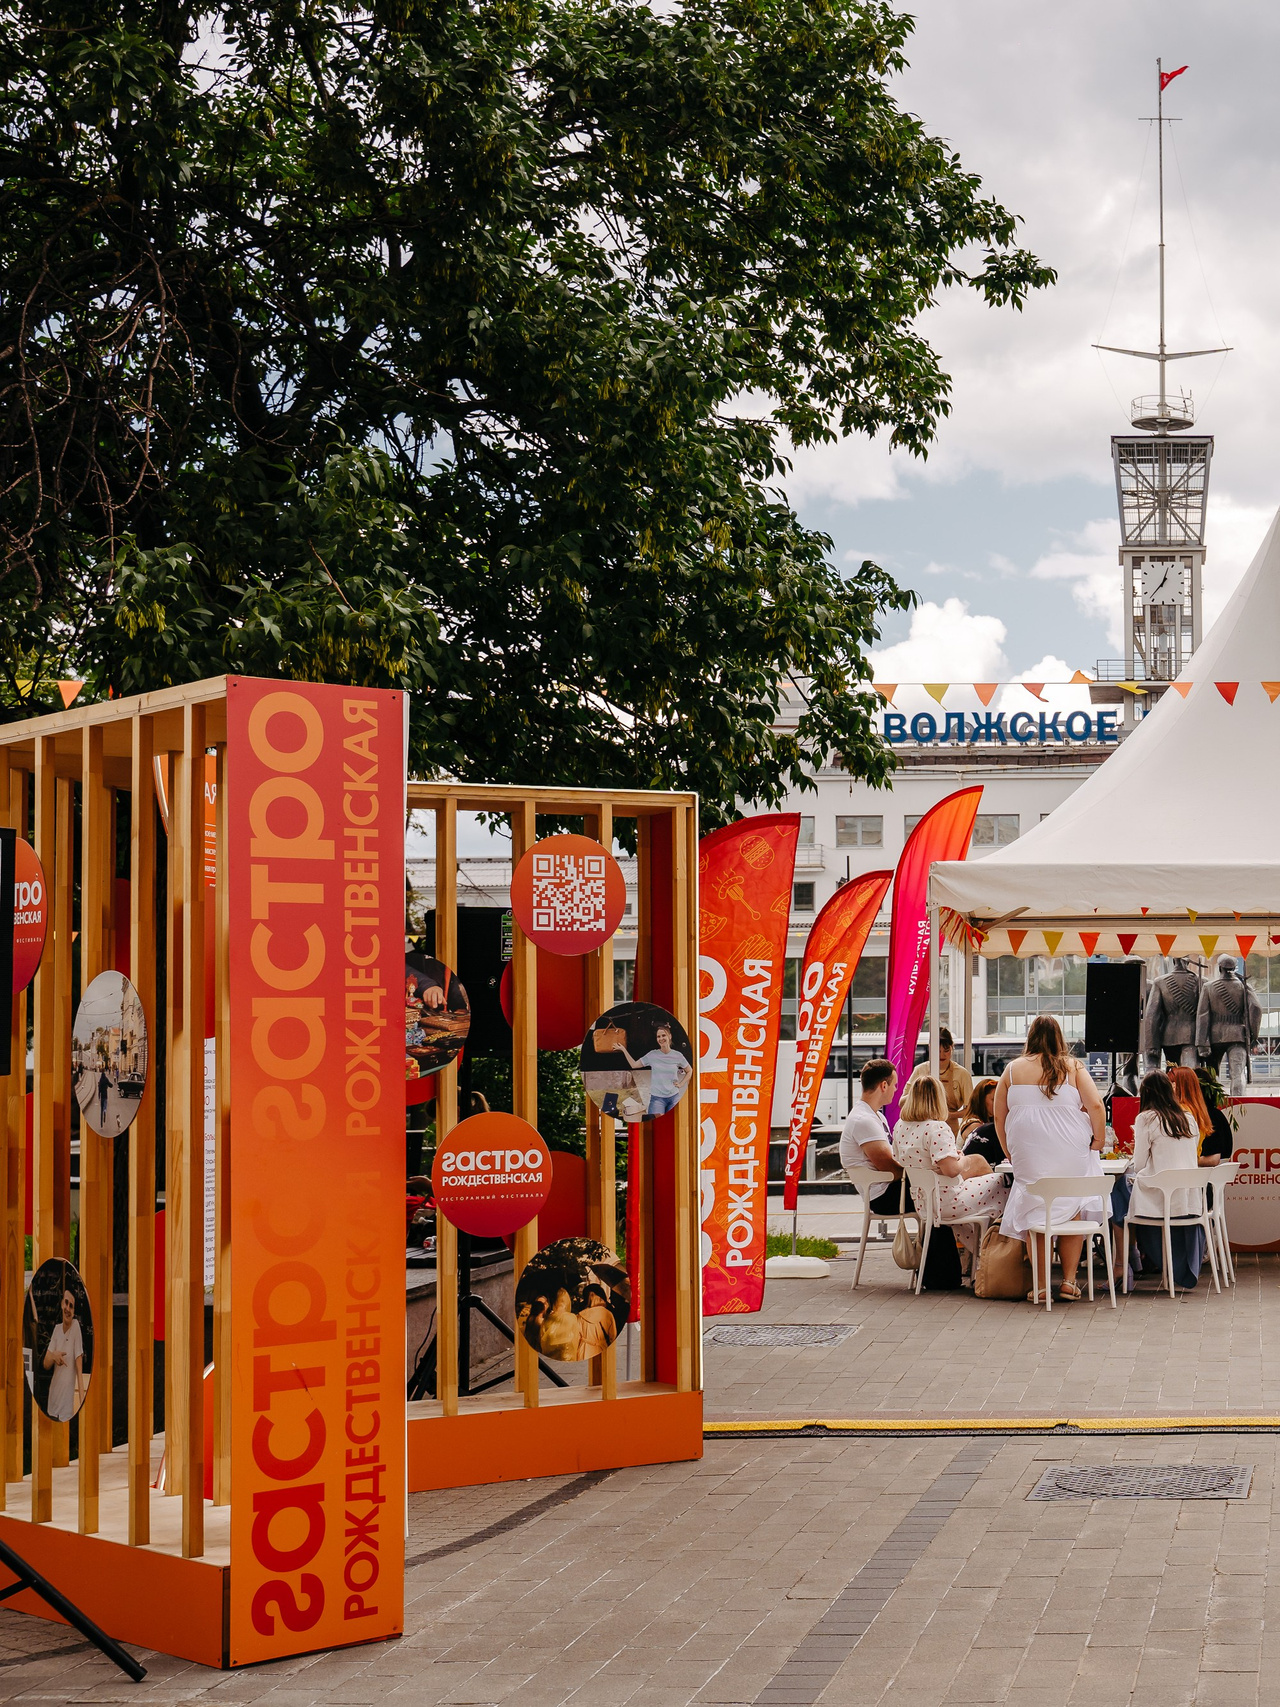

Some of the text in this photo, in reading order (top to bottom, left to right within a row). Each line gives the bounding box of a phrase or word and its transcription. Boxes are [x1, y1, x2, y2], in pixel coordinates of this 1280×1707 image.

[883, 710, 1118, 743] ВОЛЖСКОЕ
[14, 880, 42, 910] тро
[14, 910, 42, 925] ВЕНСКАЯ
[248, 691, 336, 1141] гастро
[343, 698, 387, 1136] РОЖДЕСТВЕНСКАЯ
[784, 962, 848, 1177] РОЖДЕСТВЕНСКАЯ
[726, 958, 773, 1267] РОЖДЕСТВЕНСКАЯ
[441, 1149, 543, 1172] гастро
[442, 1172, 543, 1187] РОЖДЕСТВЕНСКАЯ
